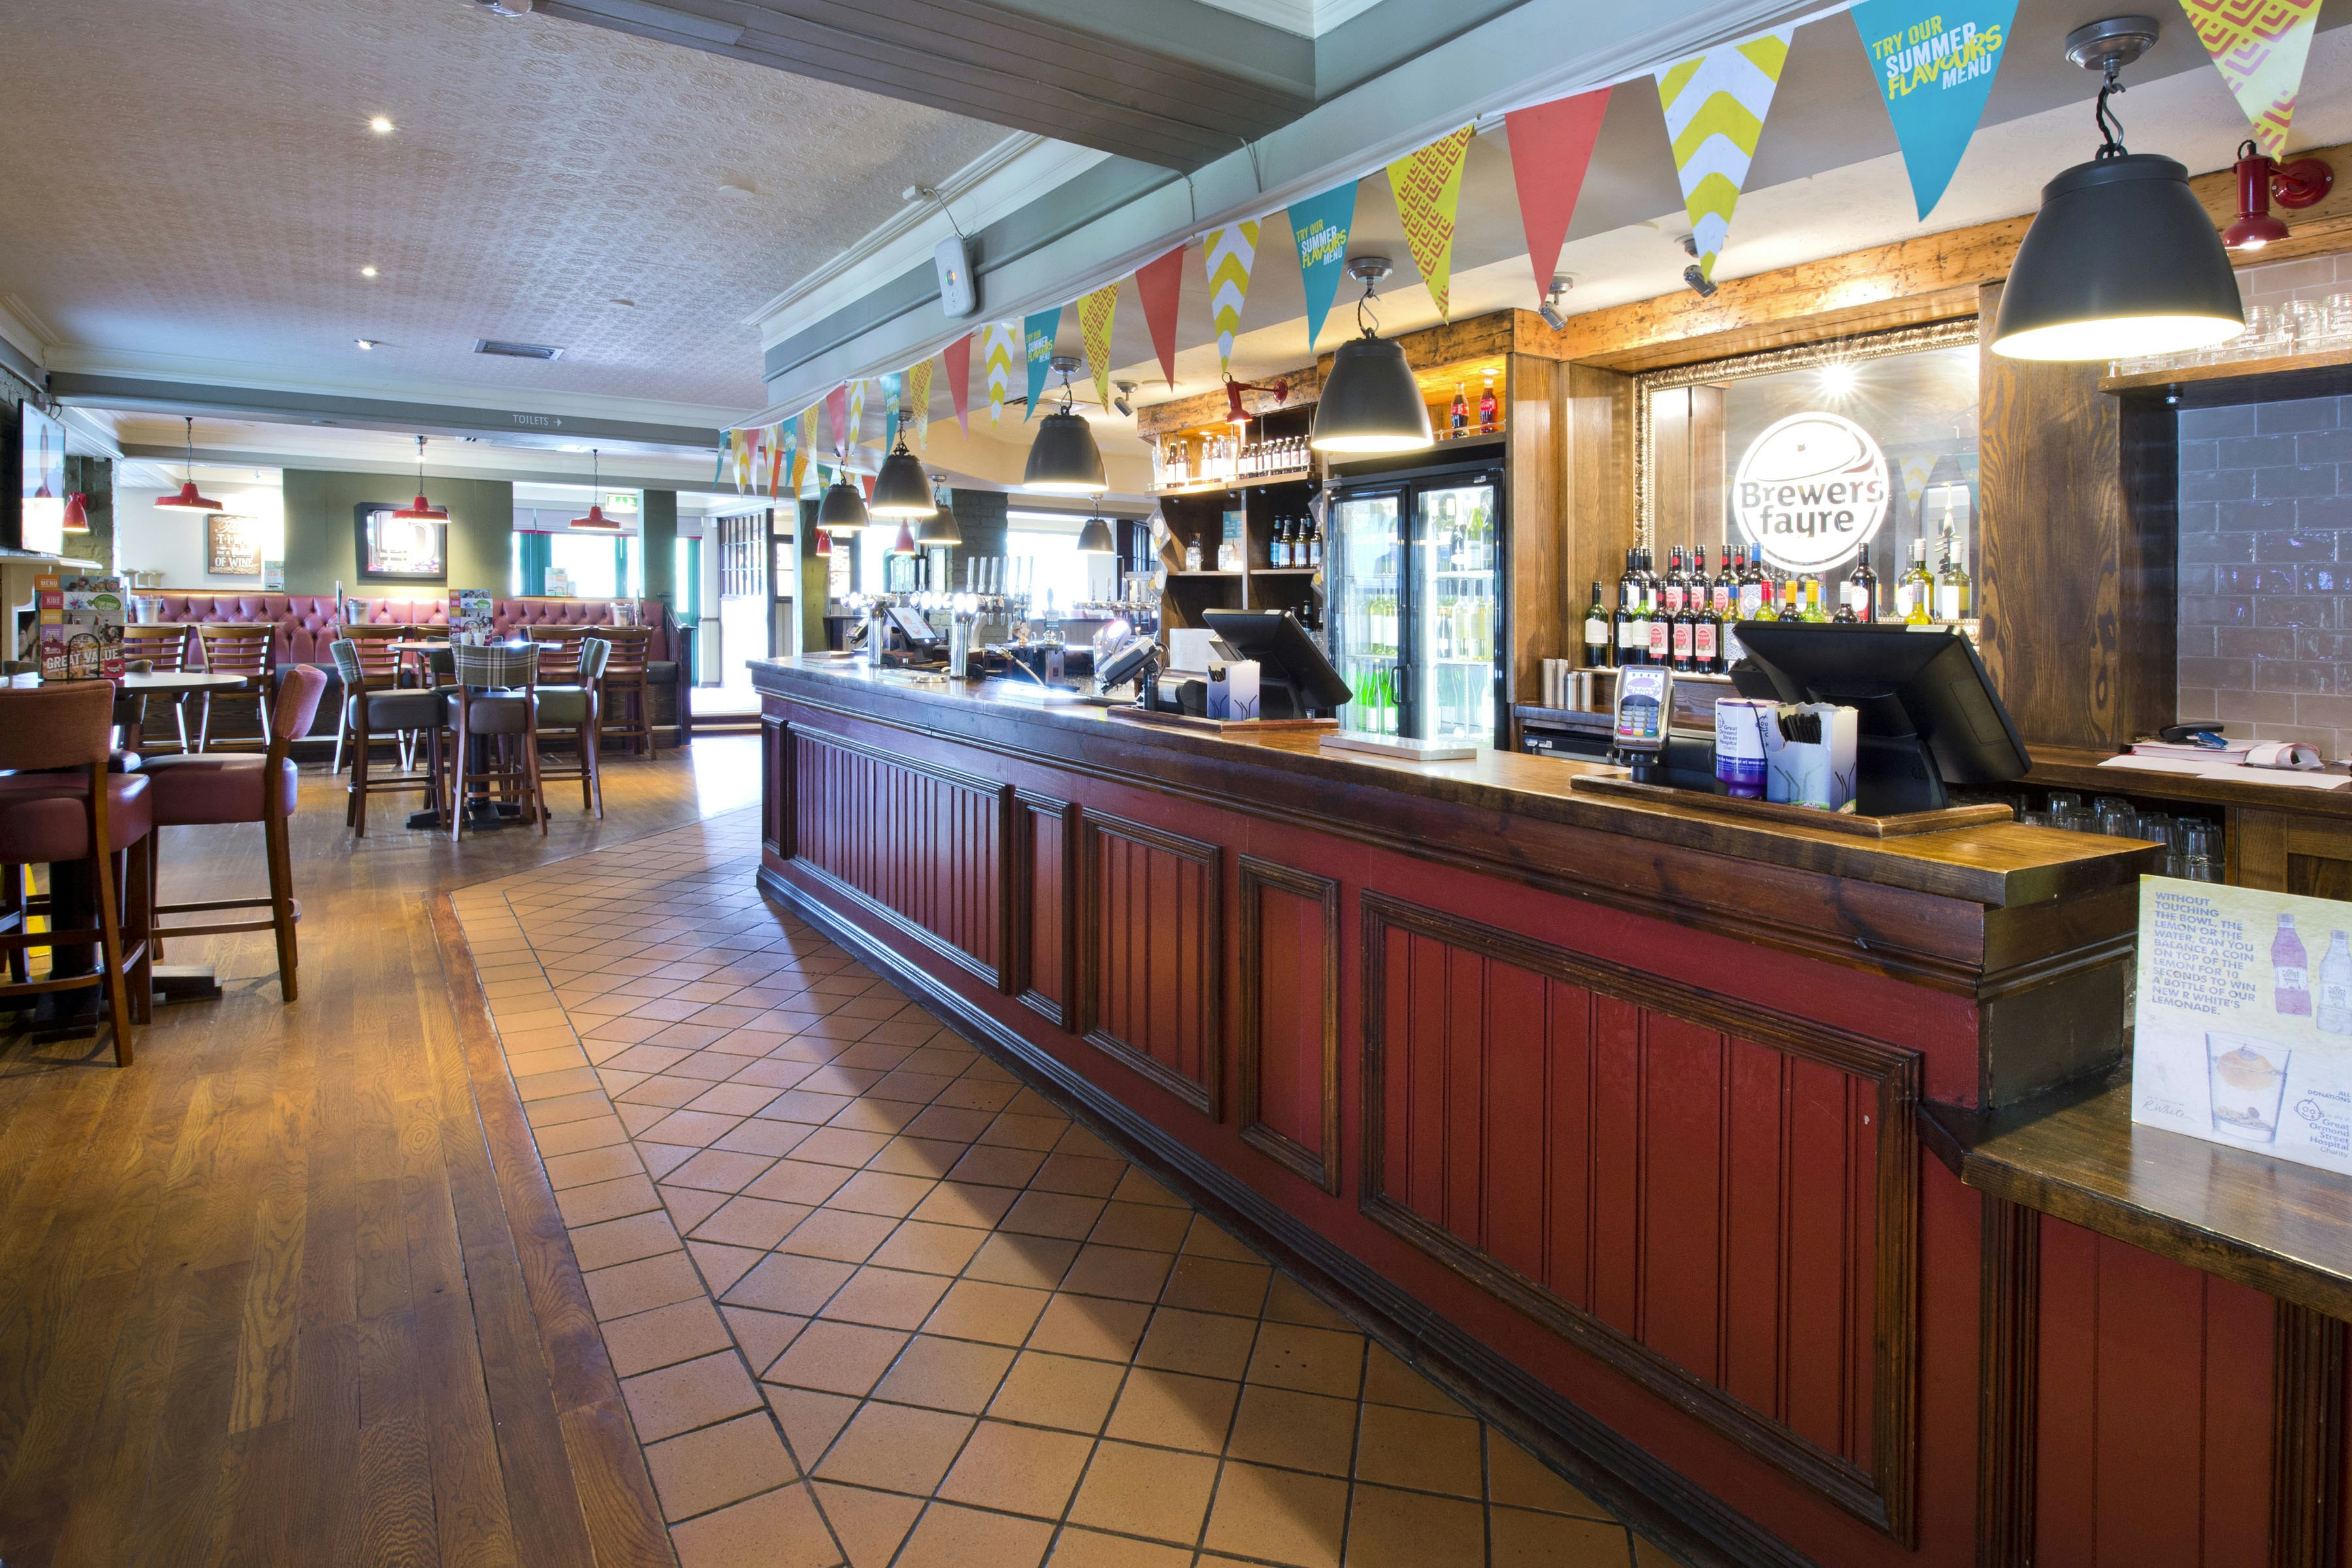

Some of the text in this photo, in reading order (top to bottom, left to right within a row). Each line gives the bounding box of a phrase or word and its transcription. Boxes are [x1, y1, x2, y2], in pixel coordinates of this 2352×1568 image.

[1872, 15, 1943, 60] TRY OUR
[1886, 22, 1976, 79] SUMMER
[1888, 25, 2002, 100] FLAVOURS
[1942, 54, 1991, 90] MENU
[1296, 219, 1323, 242] TRY OUR
[1301, 225, 1337, 255] SUMMER
[1303, 229, 1347, 269] FLAVOURS
[1324, 246, 1342, 266] MENU
[512, 414, 549, 425] TOILETS
[1740, 480, 1884, 508] Brewers
[1759, 504, 1854, 538] fayre
[215, 557, 252, 567] OF WINE
[47, 649, 119, 669] GREAT VALUE
[2155, 891, 2210, 906] WITHOUT
[2155, 901, 2219, 917] TOUCHING
[2155, 910, 2243, 931] THE BOWL, THE
[2155, 920, 2242, 940] LEMON OR THE
[2154, 929, 2253, 952] WATER, CAN YOU
[2154, 939, 2207, 954] BALANCE
[2223, 950, 2253, 962] COIN
[2153, 958, 2238, 979] LEMON FOR 10
[2154, 948, 2244, 970] ON TOP OF THE
[2152, 976, 2255, 1002] A BOTTLE OF OUR
[2153, 967, 2256, 992] SECONDS TO WIN
[2152, 985, 2179, 997] NEW
[2193, 992, 2240, 1009] WHITE'S
[2152, 994, 2220, 1015] LEMONADE.
[2308, 1090, 2351, 1103] DONATIONS
[2310, 1122, 2349, 1137] Ormond
[2323, 1119, 2349, 1130] Great
[2310, 1136, 2349, 1151] Hospital
[2320, 1132, 2349, 1144] Street
[2320, 1146, 2349, 1158] Charity
